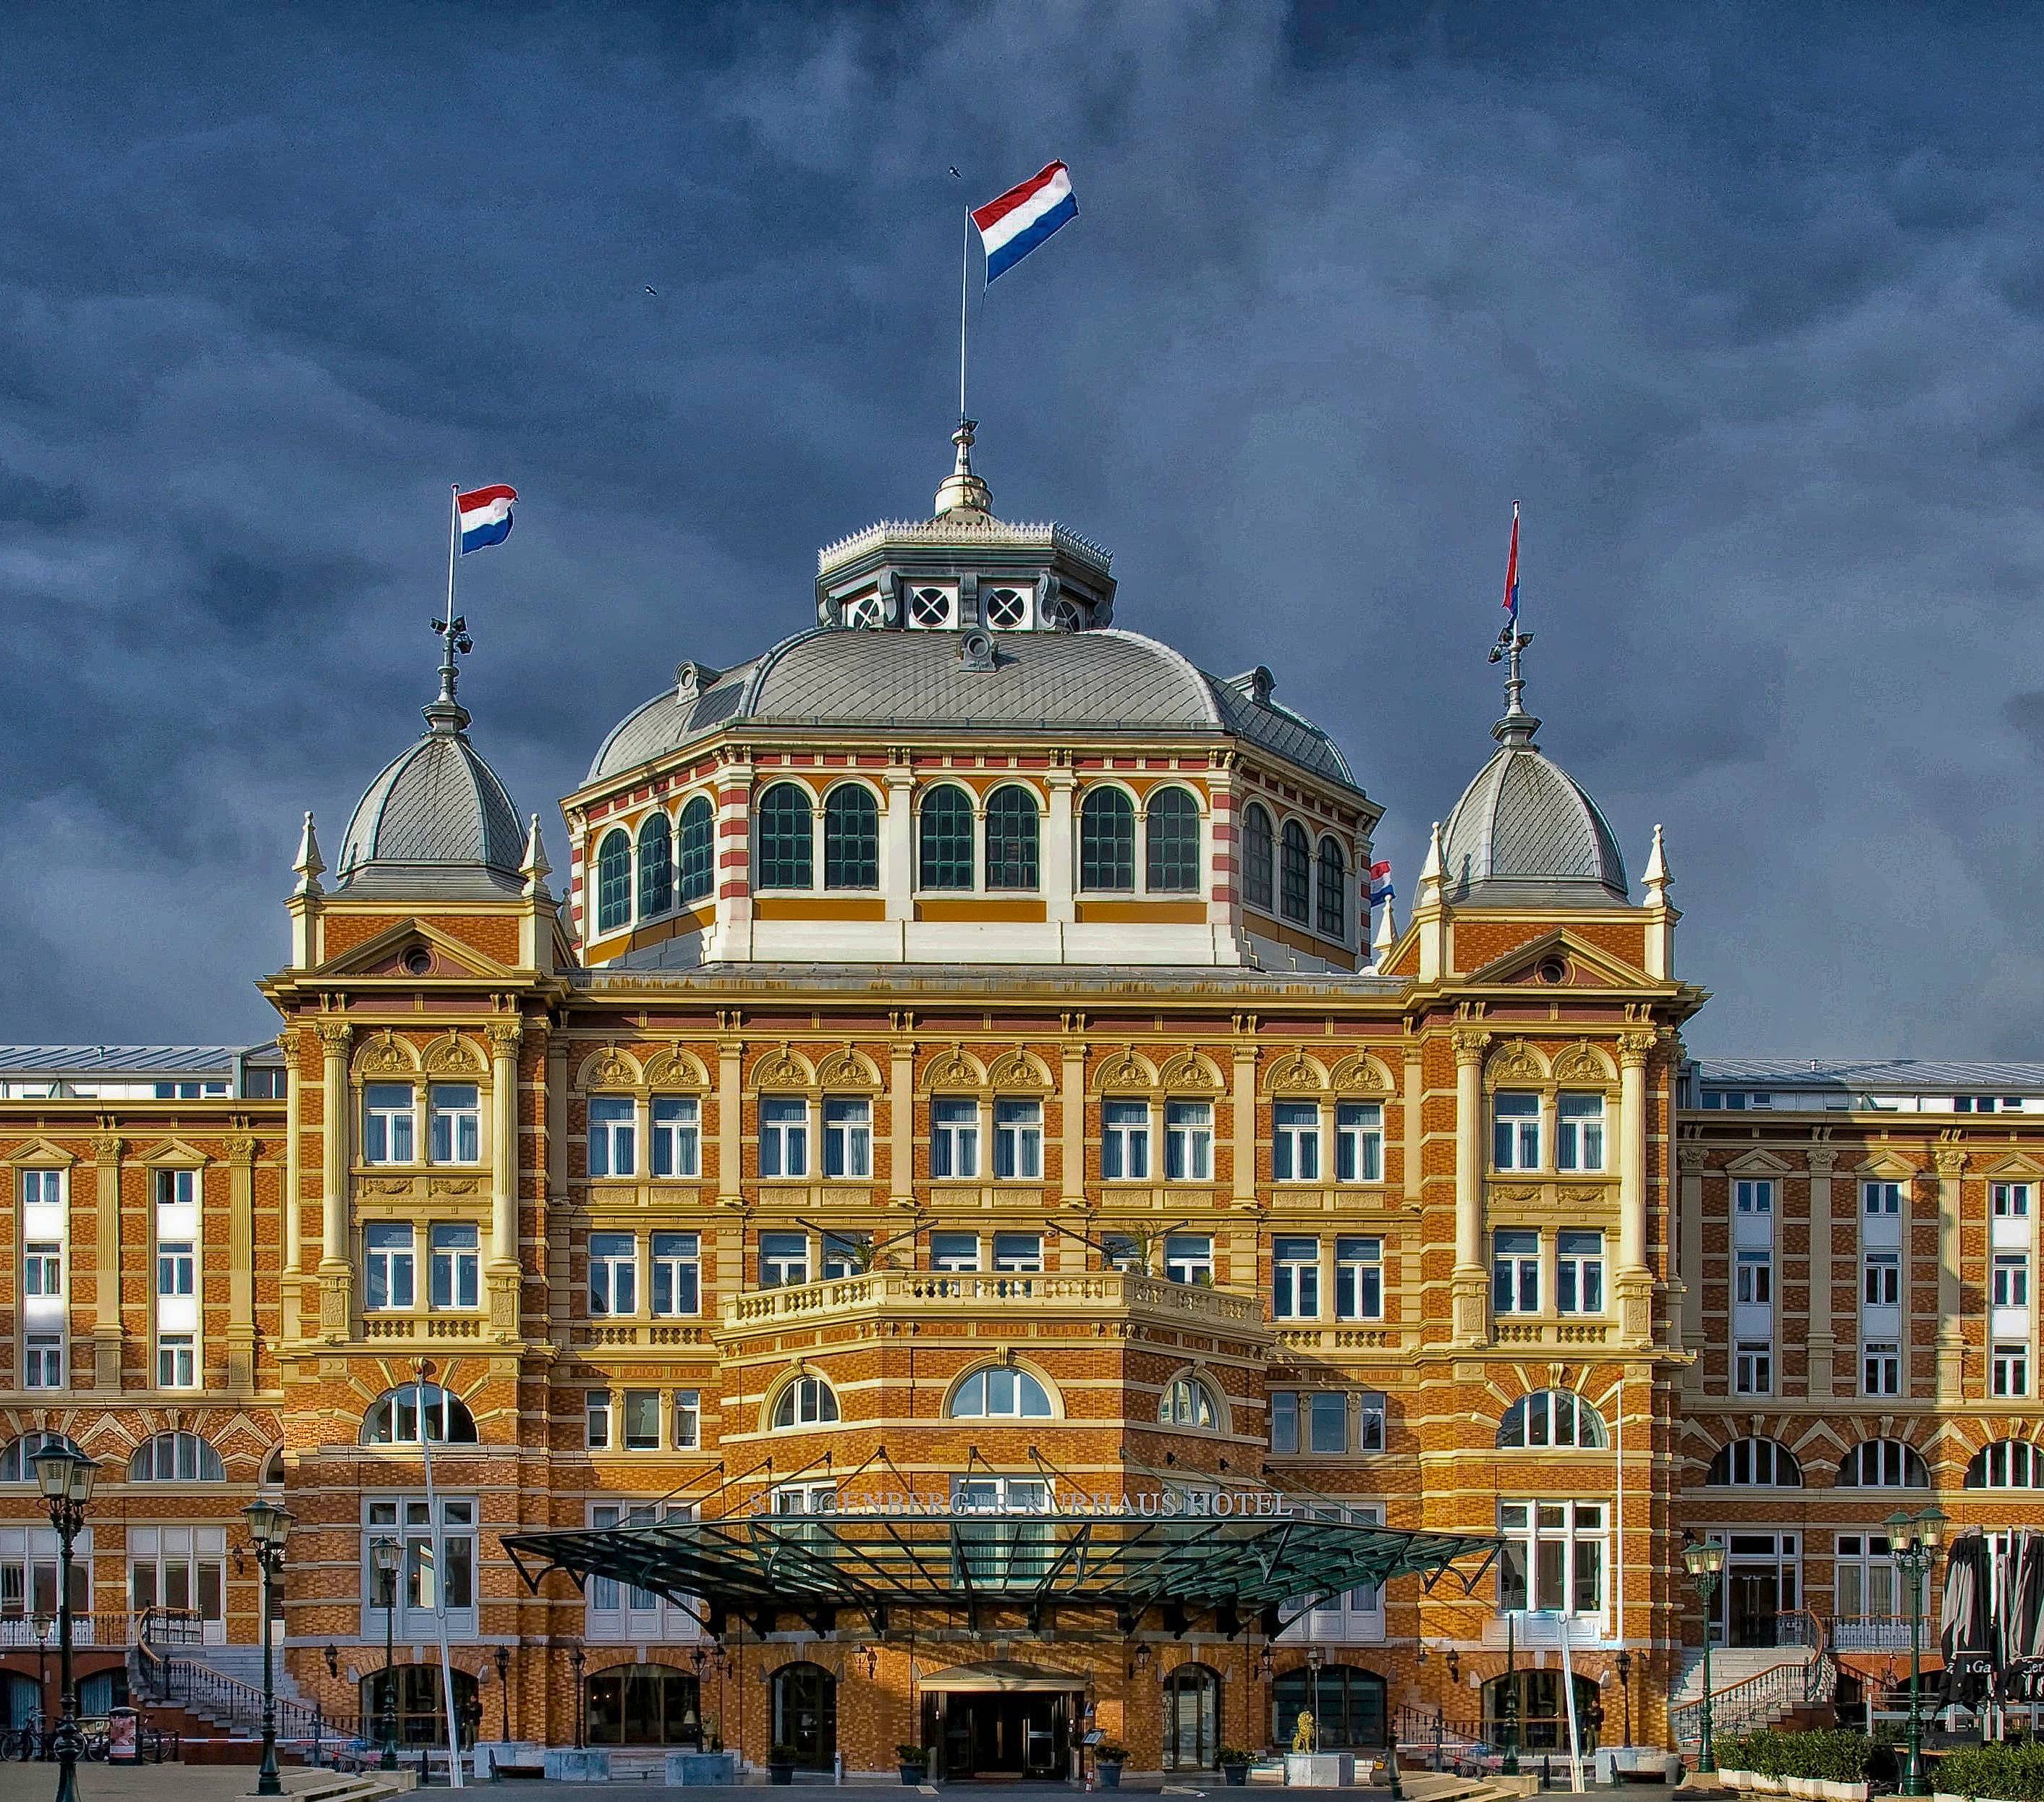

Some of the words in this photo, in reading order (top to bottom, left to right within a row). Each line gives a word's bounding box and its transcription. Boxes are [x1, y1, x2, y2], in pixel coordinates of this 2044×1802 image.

[748, 1492, 1013, 1516] STEIGENBERGER
[1023, 1492, 1176, 1517] KURHAUS
[1188, 1492, 1293, 1517] HOTEL
